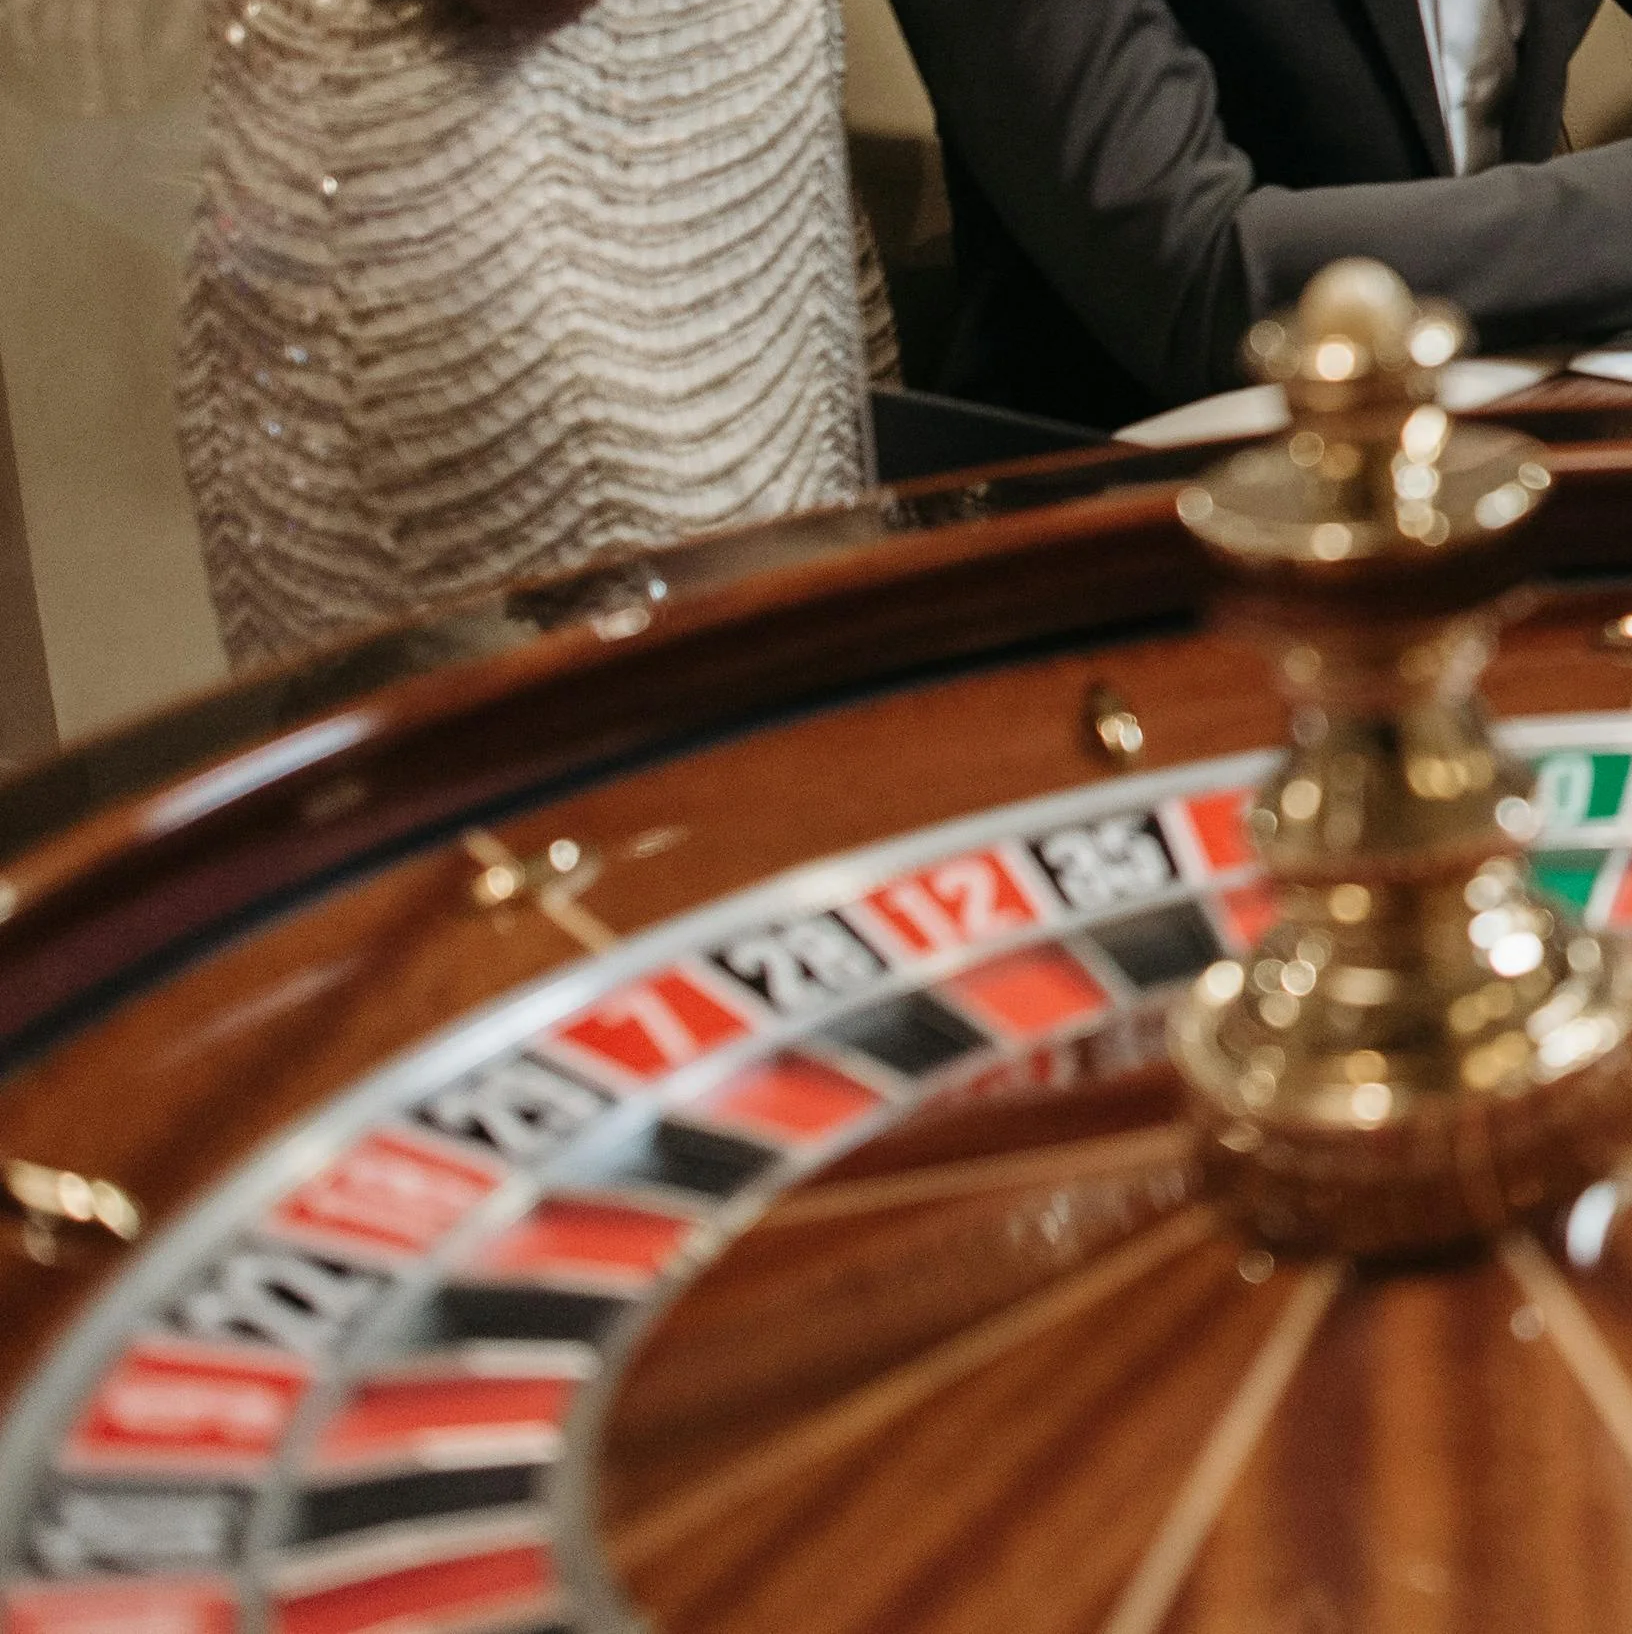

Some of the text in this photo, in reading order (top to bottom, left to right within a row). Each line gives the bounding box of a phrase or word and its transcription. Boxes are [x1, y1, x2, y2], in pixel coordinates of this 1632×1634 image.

[878, 856, 1006, 956] 12
[1038, 819, 1168, 910] 35
[594, 972, 700, 1072] 7
